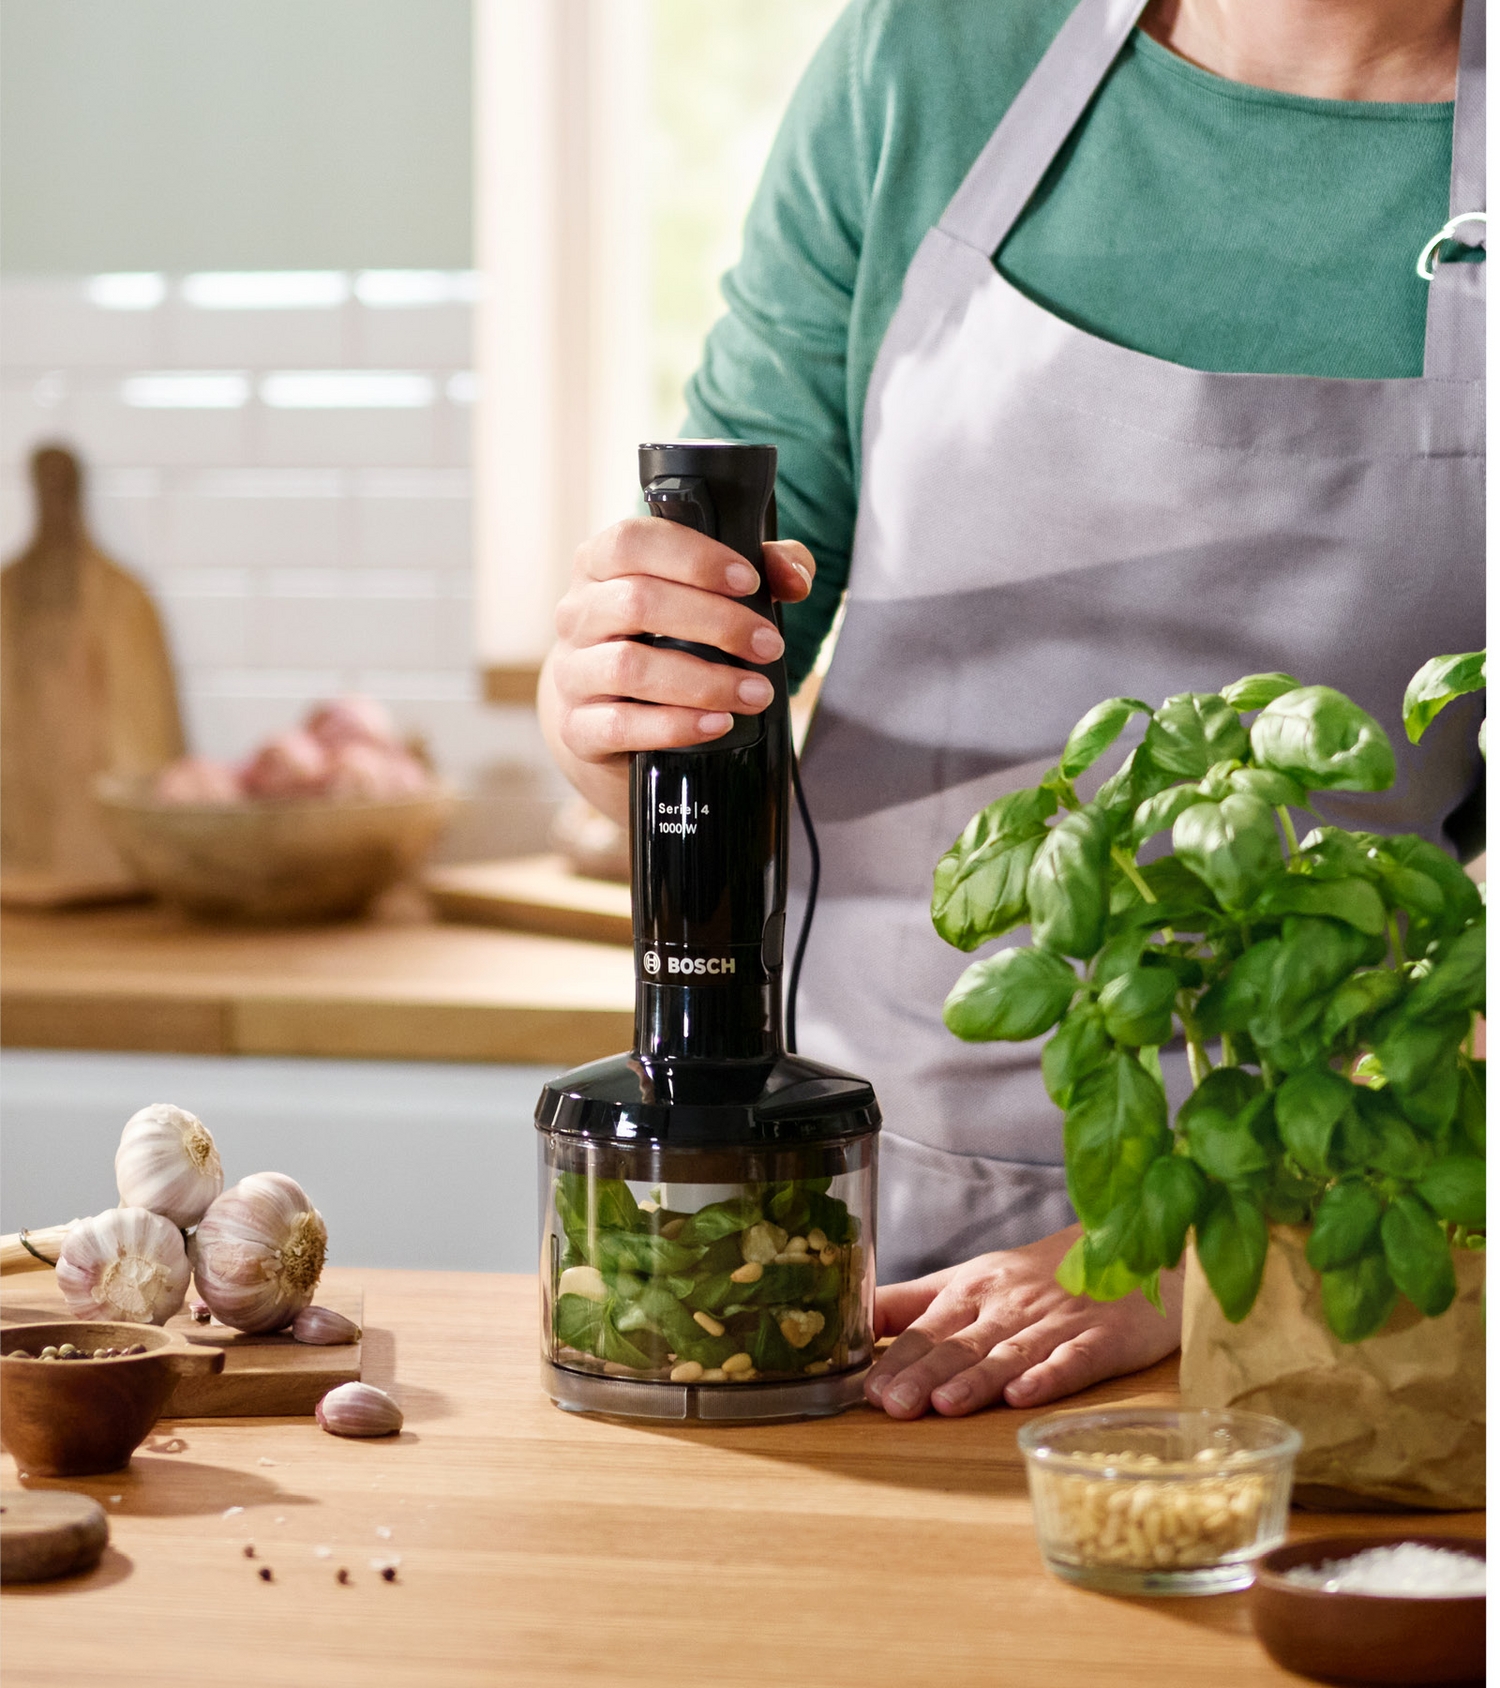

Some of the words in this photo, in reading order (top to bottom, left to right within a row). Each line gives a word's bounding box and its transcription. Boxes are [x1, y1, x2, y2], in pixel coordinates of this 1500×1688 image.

[659, 822, 682, 834] 1000
[686, 823, 697, 834] W
[668, 957, 736, 974] BOSCH
